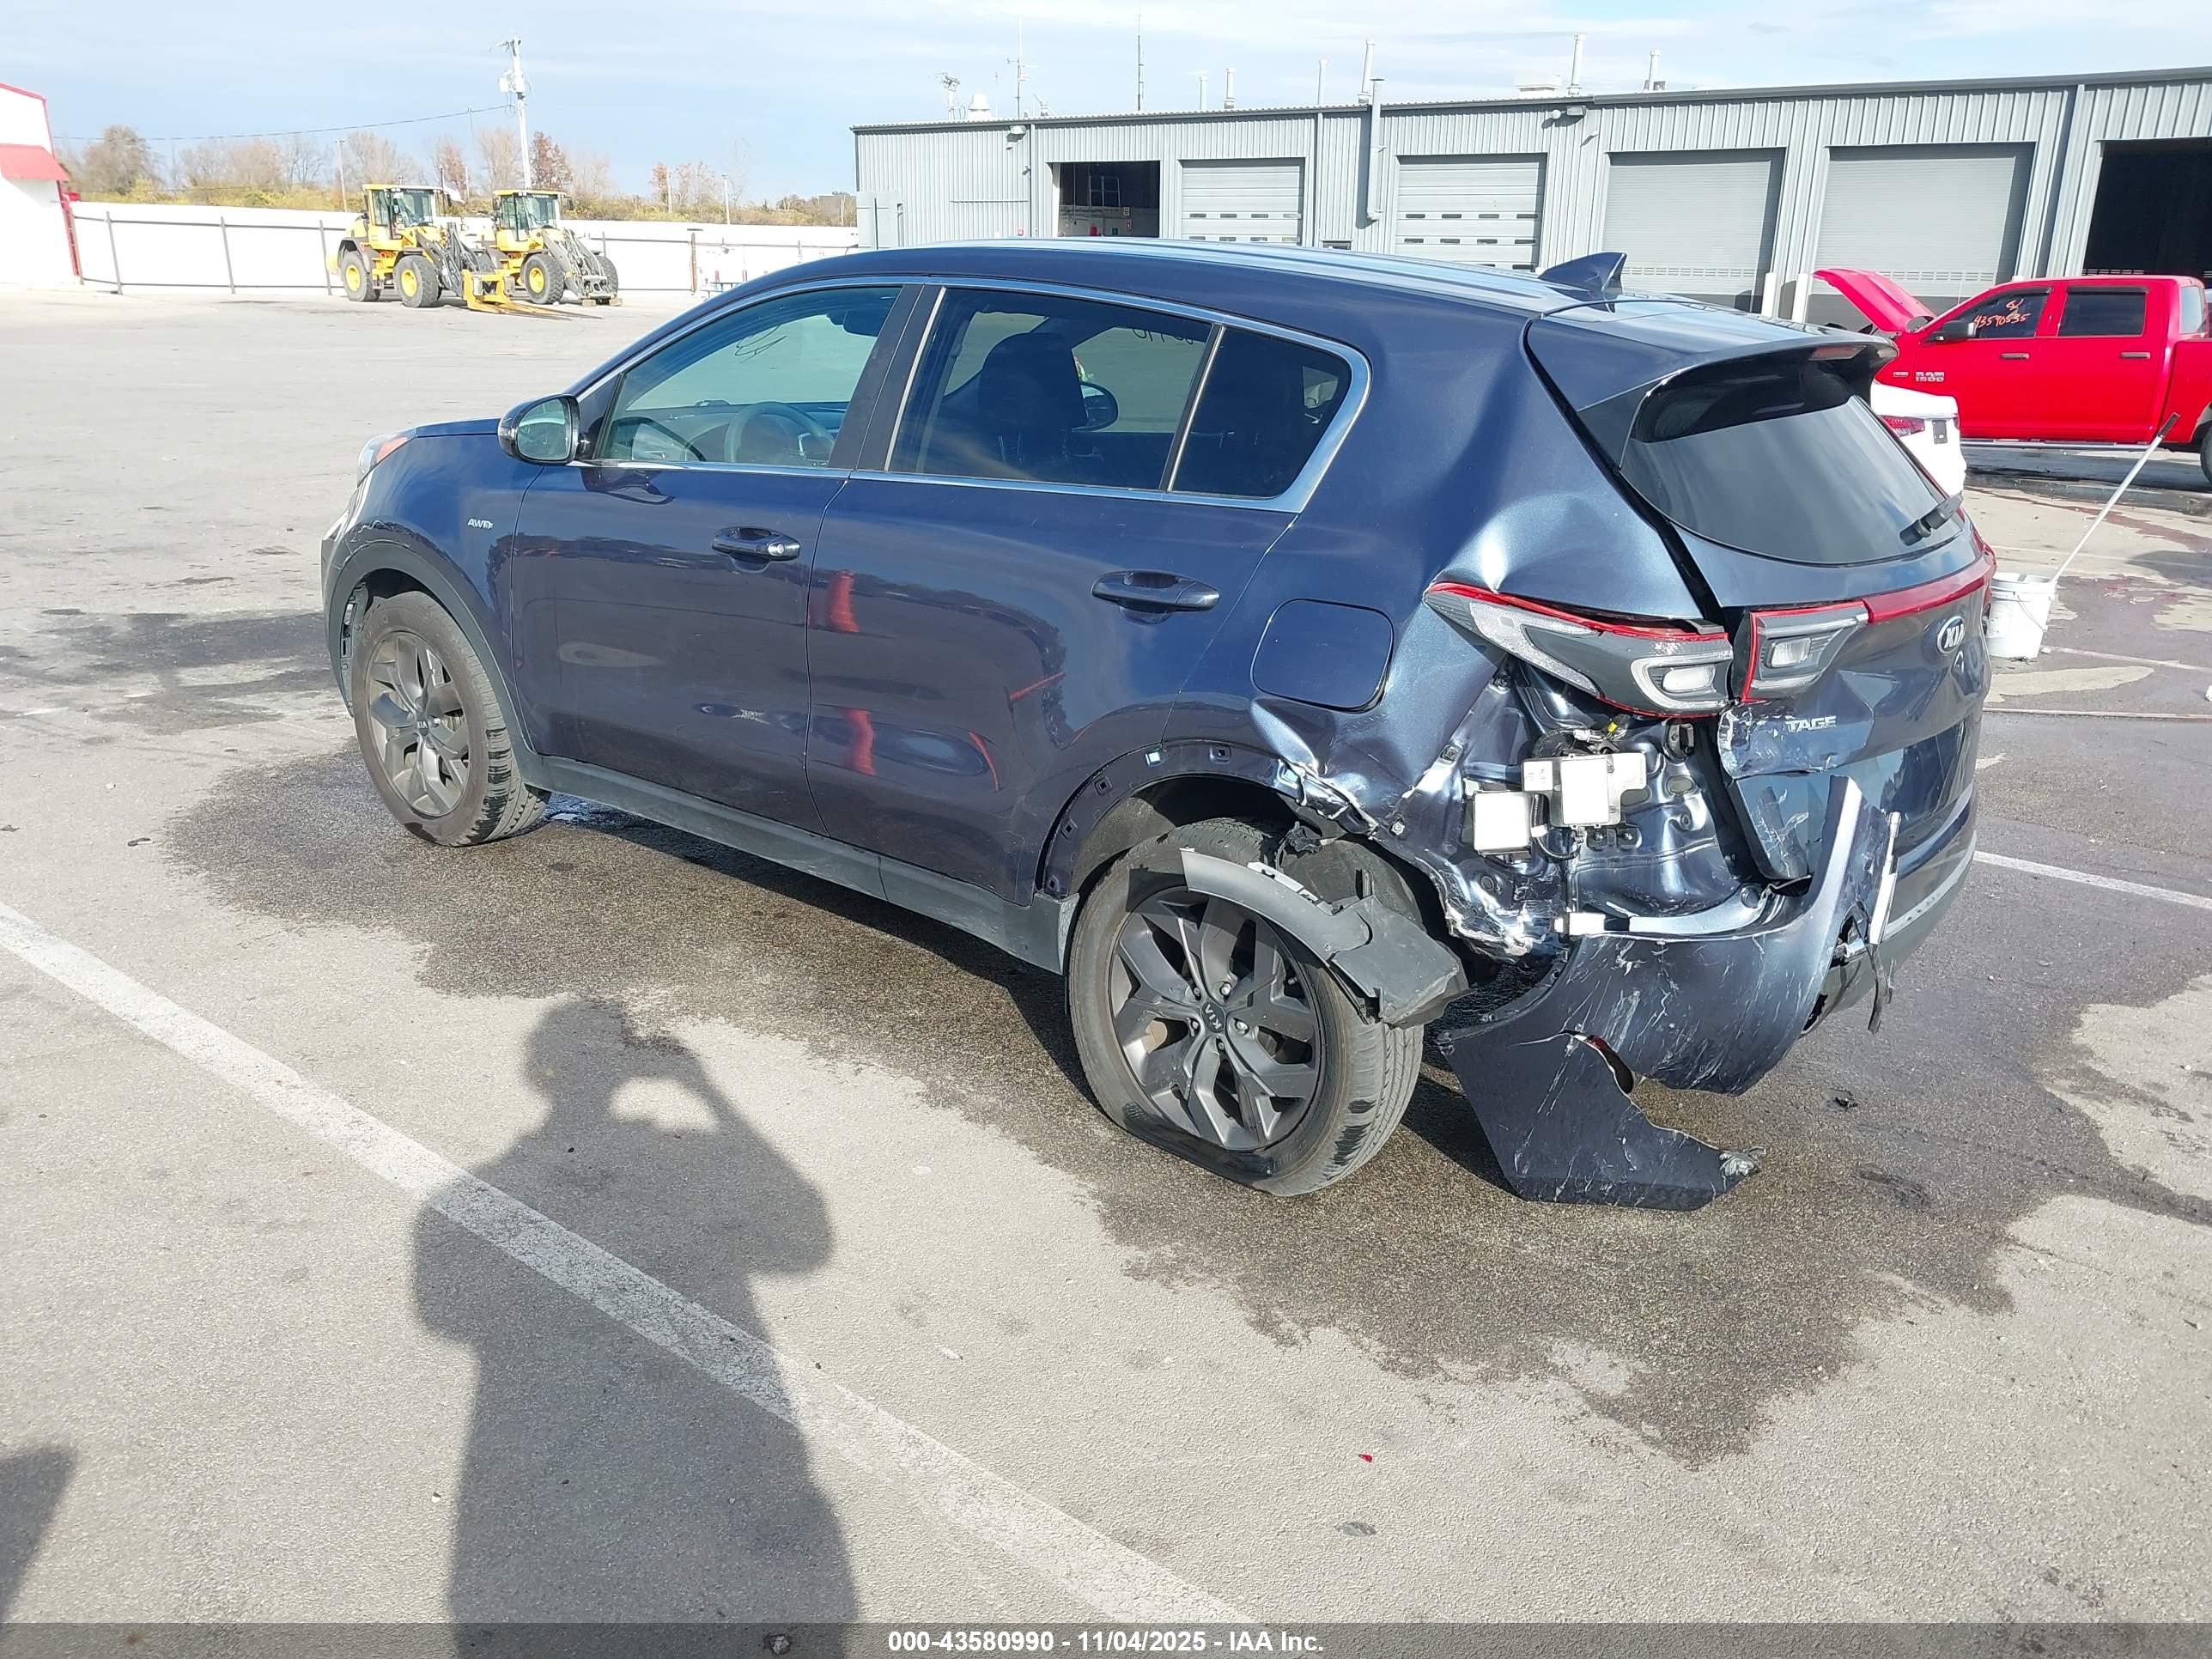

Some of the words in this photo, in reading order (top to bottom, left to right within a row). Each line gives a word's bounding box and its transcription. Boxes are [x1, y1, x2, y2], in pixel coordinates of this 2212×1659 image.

[467, 518, 493, 529] AWD
[1943, 623, 1965, 649] KIA
[417, 720, 428, 729] KIA
[1785, 715, 1837, 733] TAGE
[1205, 1004, 1223, 1030] KIA
